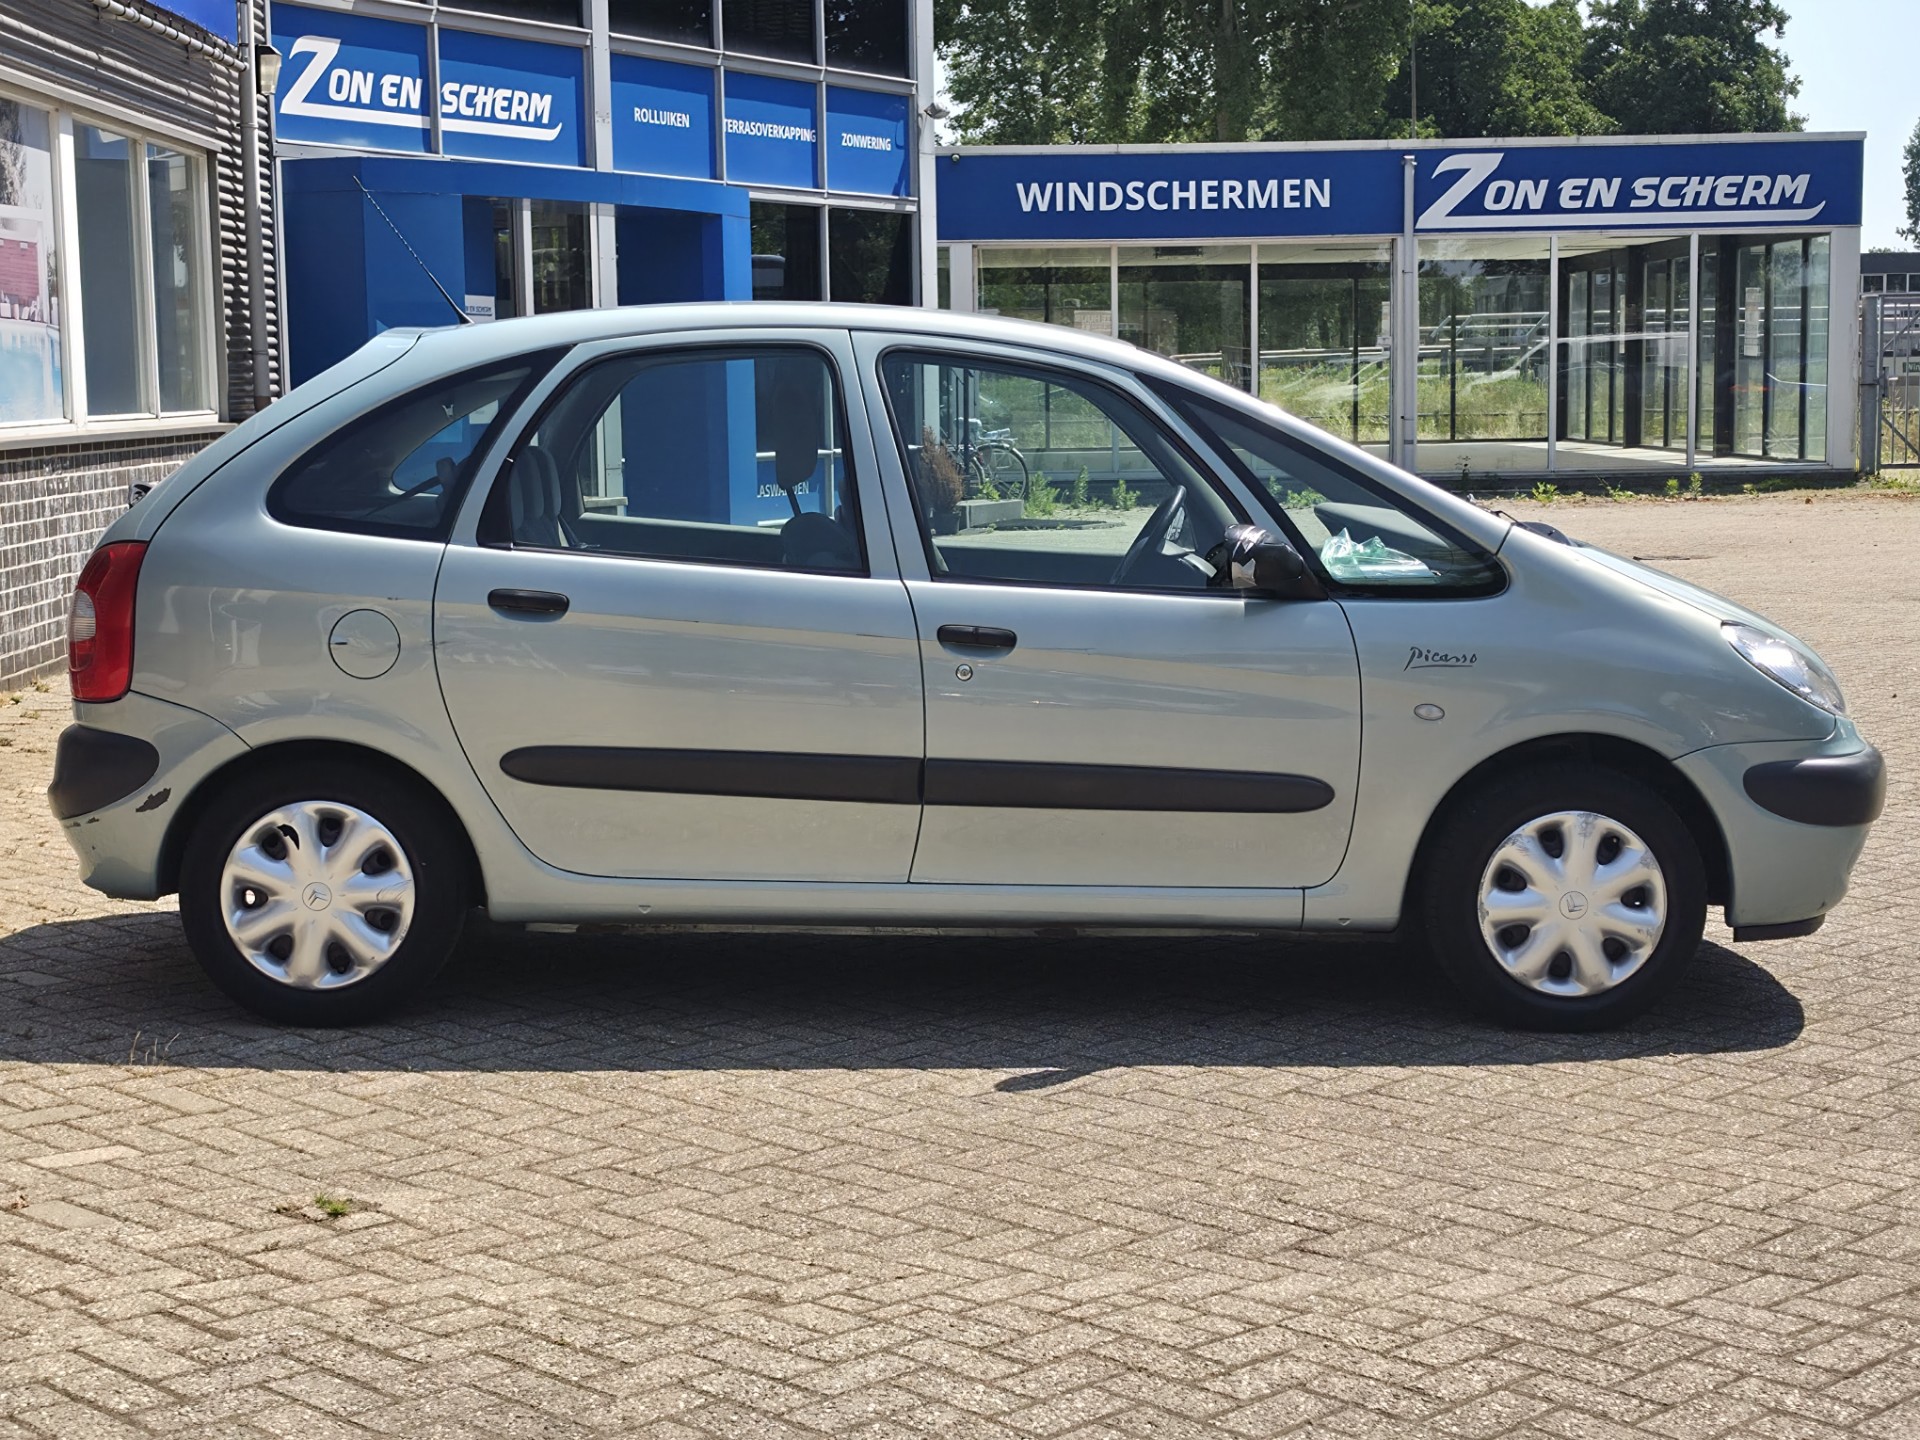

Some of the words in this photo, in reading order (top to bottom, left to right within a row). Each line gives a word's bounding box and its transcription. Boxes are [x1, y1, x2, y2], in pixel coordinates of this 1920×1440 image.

[279, 35, 374, 114] ZON
[380, 74, 423, 109] EN
[441, 82, 552, 124] SCHERM
[633, 106, 690, 128] ROLLUIKEN
[841, 132, 892, 151] ZONWERING
[1016, 178, 1331, 212] WINDSCHERMEN
[1415, 153, 1548, 229] ZON
[1557, 177, 1622, 208] EN
[1630, 173, 1811, 208] SCHERM
[1403, 646, 1478, 672] Picasso
